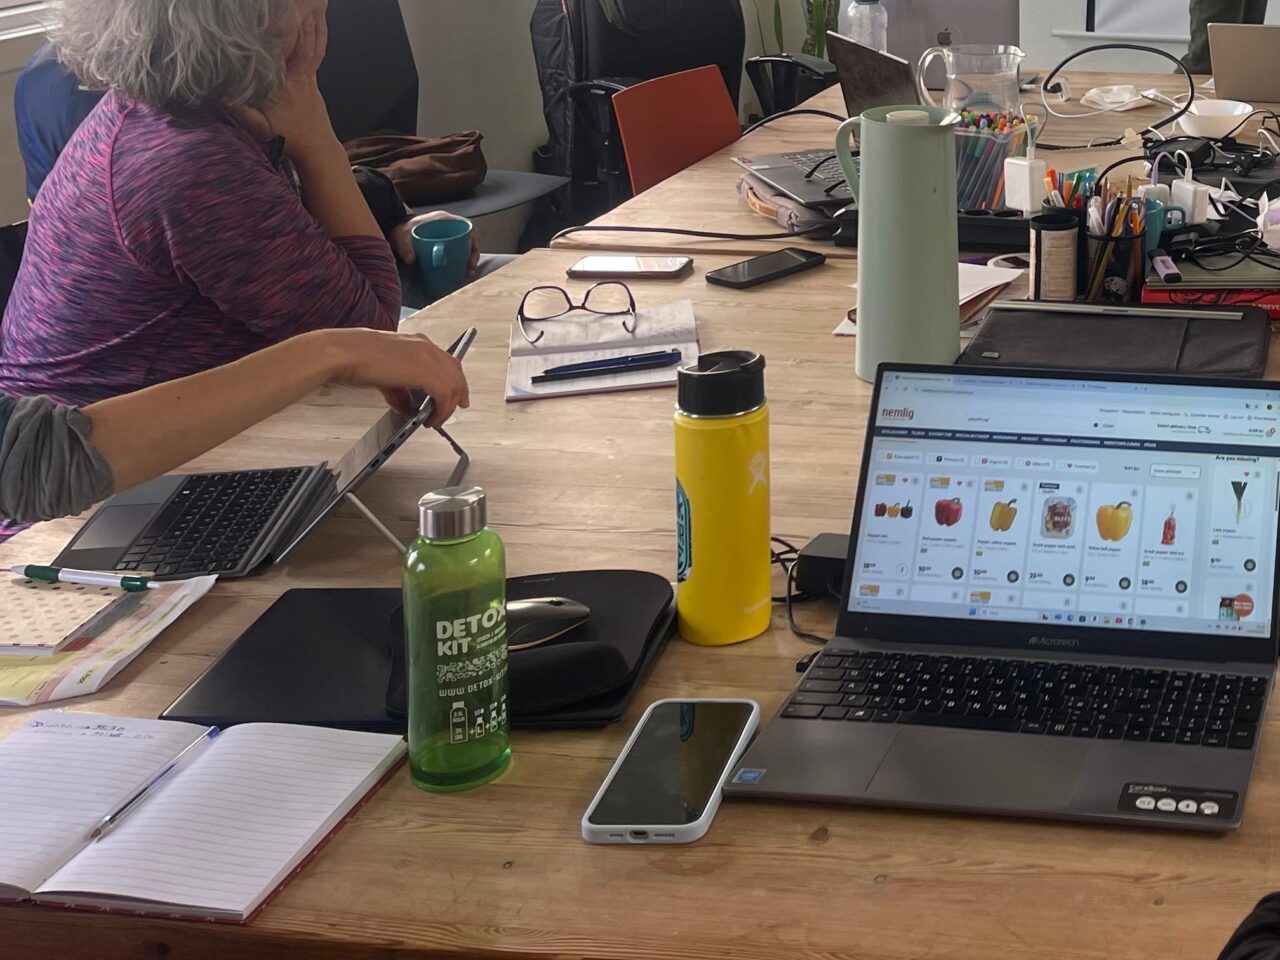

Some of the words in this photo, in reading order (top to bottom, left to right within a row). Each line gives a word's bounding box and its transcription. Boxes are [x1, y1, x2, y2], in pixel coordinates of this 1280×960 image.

[882, 407, 914, 420] nemlig
[436, 598, 507, 640] DETOX
[437, 637, 471, 657] KIT
